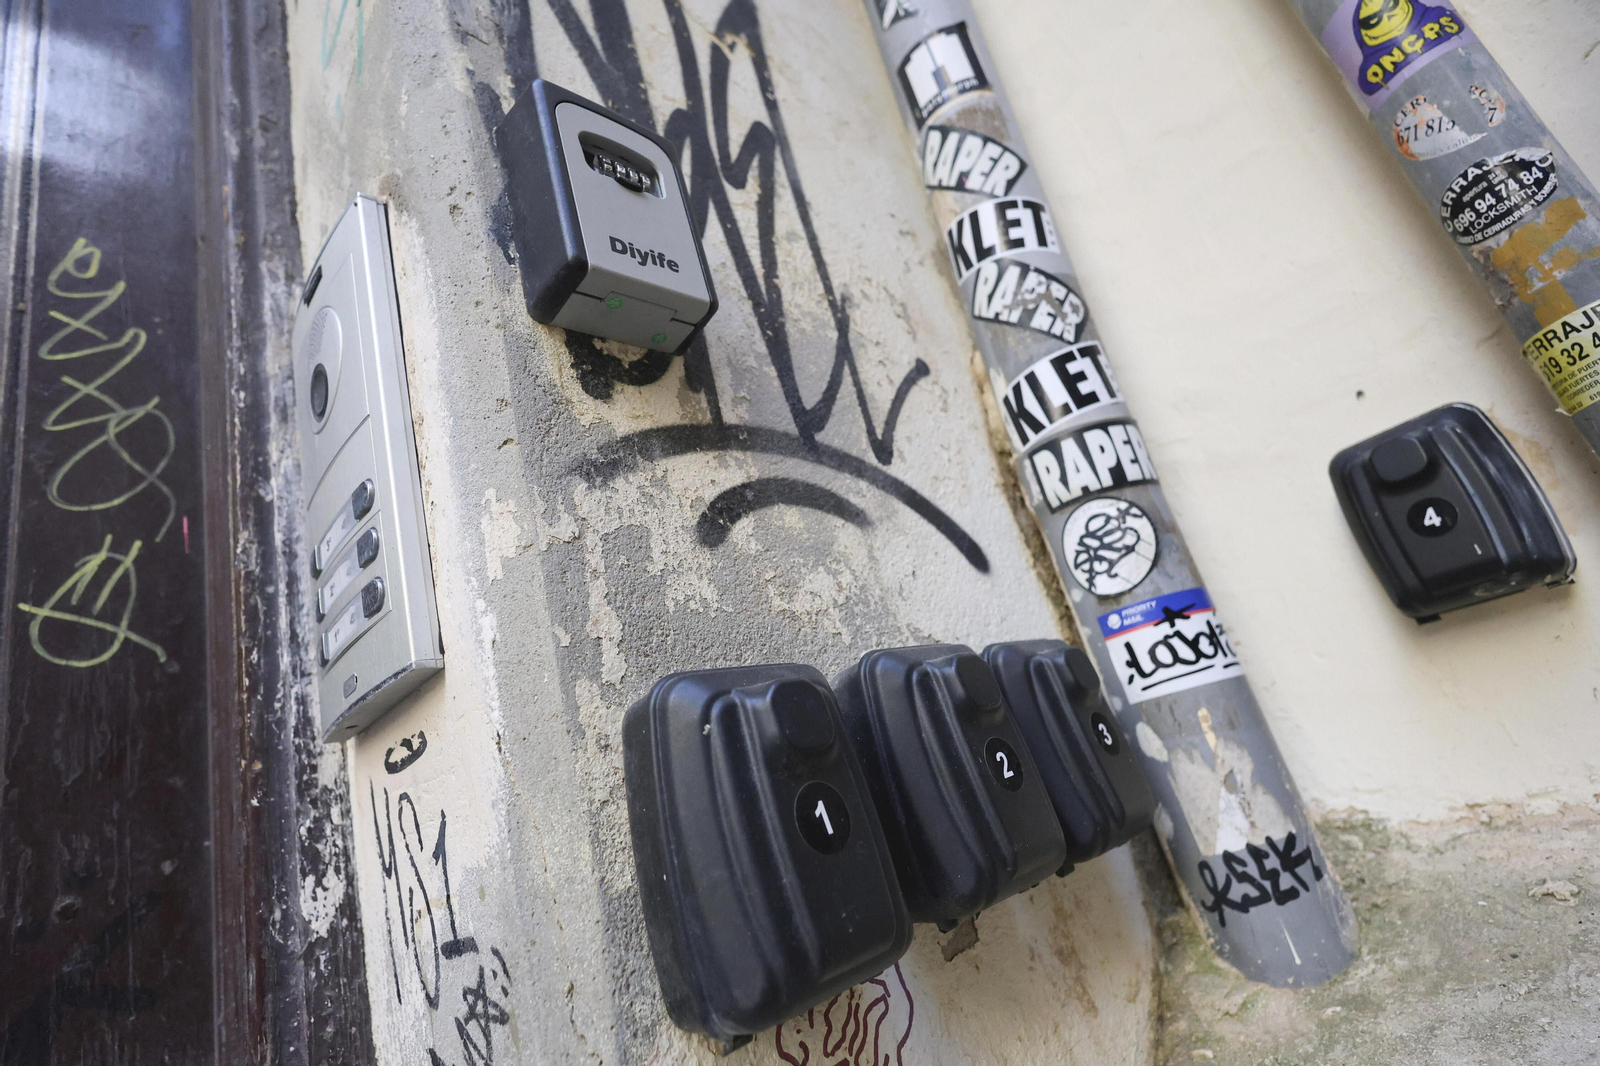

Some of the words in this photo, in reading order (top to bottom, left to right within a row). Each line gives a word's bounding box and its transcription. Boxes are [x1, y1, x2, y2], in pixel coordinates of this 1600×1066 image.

[925, 129, 1021, 197] RAPER
[1441, 152, 1553, 232] CERRAJO
[1453, 208, 1476, 232] 696
[1474, 192, 1496, 213] 94
[1495, 178, 1520, 198] 74
[1520, 166, 1544, 185] 84
[1469, 185, 1538, 234] LOCKSMITH
[1483, 203, 1532, 238] CERRADURAS
[608, 235, 680, 273] Diyife
[974, 261, 1085, 342] RAPER
[1560, 342, 1590, 366] 32
[1423, 506, 1442, 528] 4
[1122, 599, 1157, 618] PRIORITY
[1123, 613, 1145, 626] MAIL
[1097, 722, 1113, 745] 3
[995, 751, 1014, 779] 2
[814, 800, 834, 835] 1
